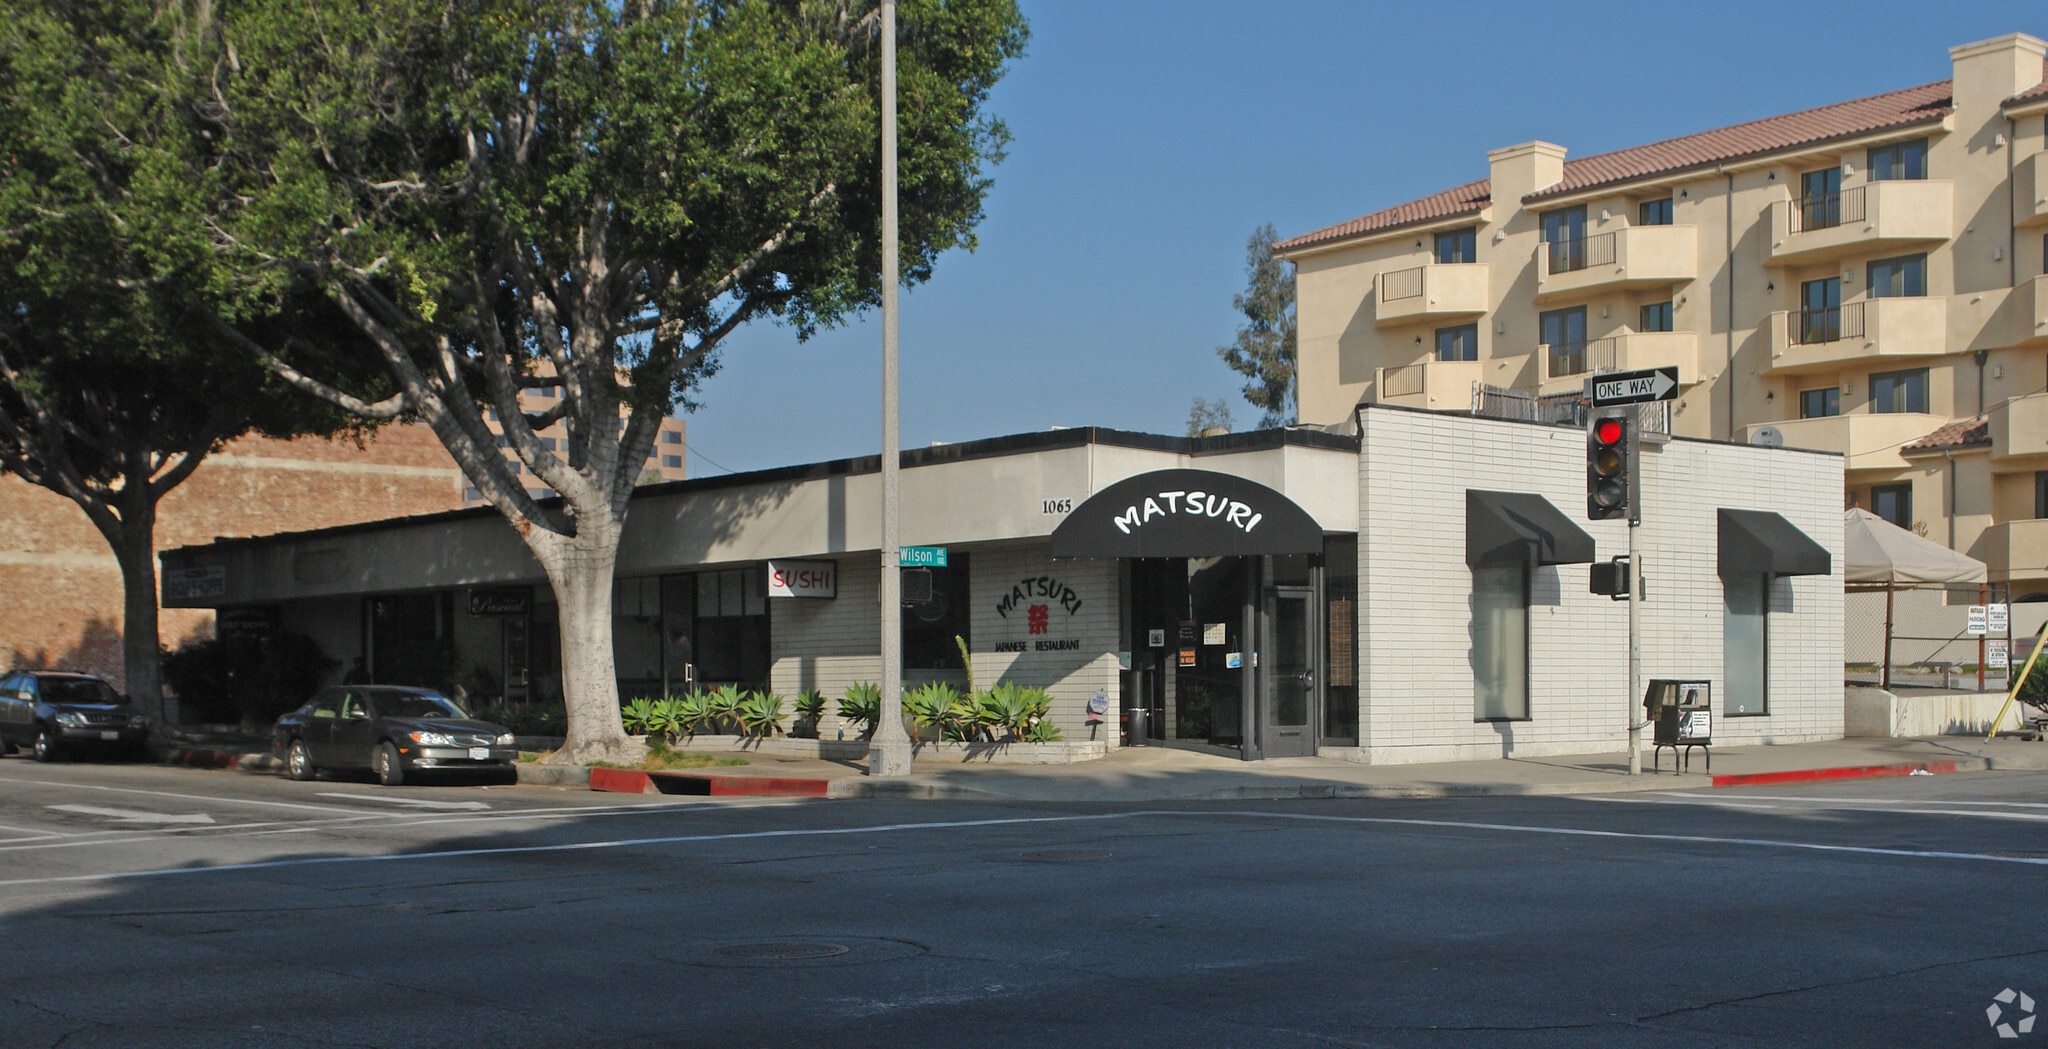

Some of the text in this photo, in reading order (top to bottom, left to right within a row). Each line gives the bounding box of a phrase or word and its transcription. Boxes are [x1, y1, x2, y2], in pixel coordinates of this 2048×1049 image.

[1598, 378, 1655, 398] ONE WAY
[1042, 499, 1072, 514] 1065
[1114, 491, 1263, 534] MATSURI
[900, 547, 933, 562] Wilson
[773, 569, 830, 589] SUSHI
[996, 576, 1082, 619] MATSURI
[995, 640, 1079, 652] JAPANESE RESTAURANT
